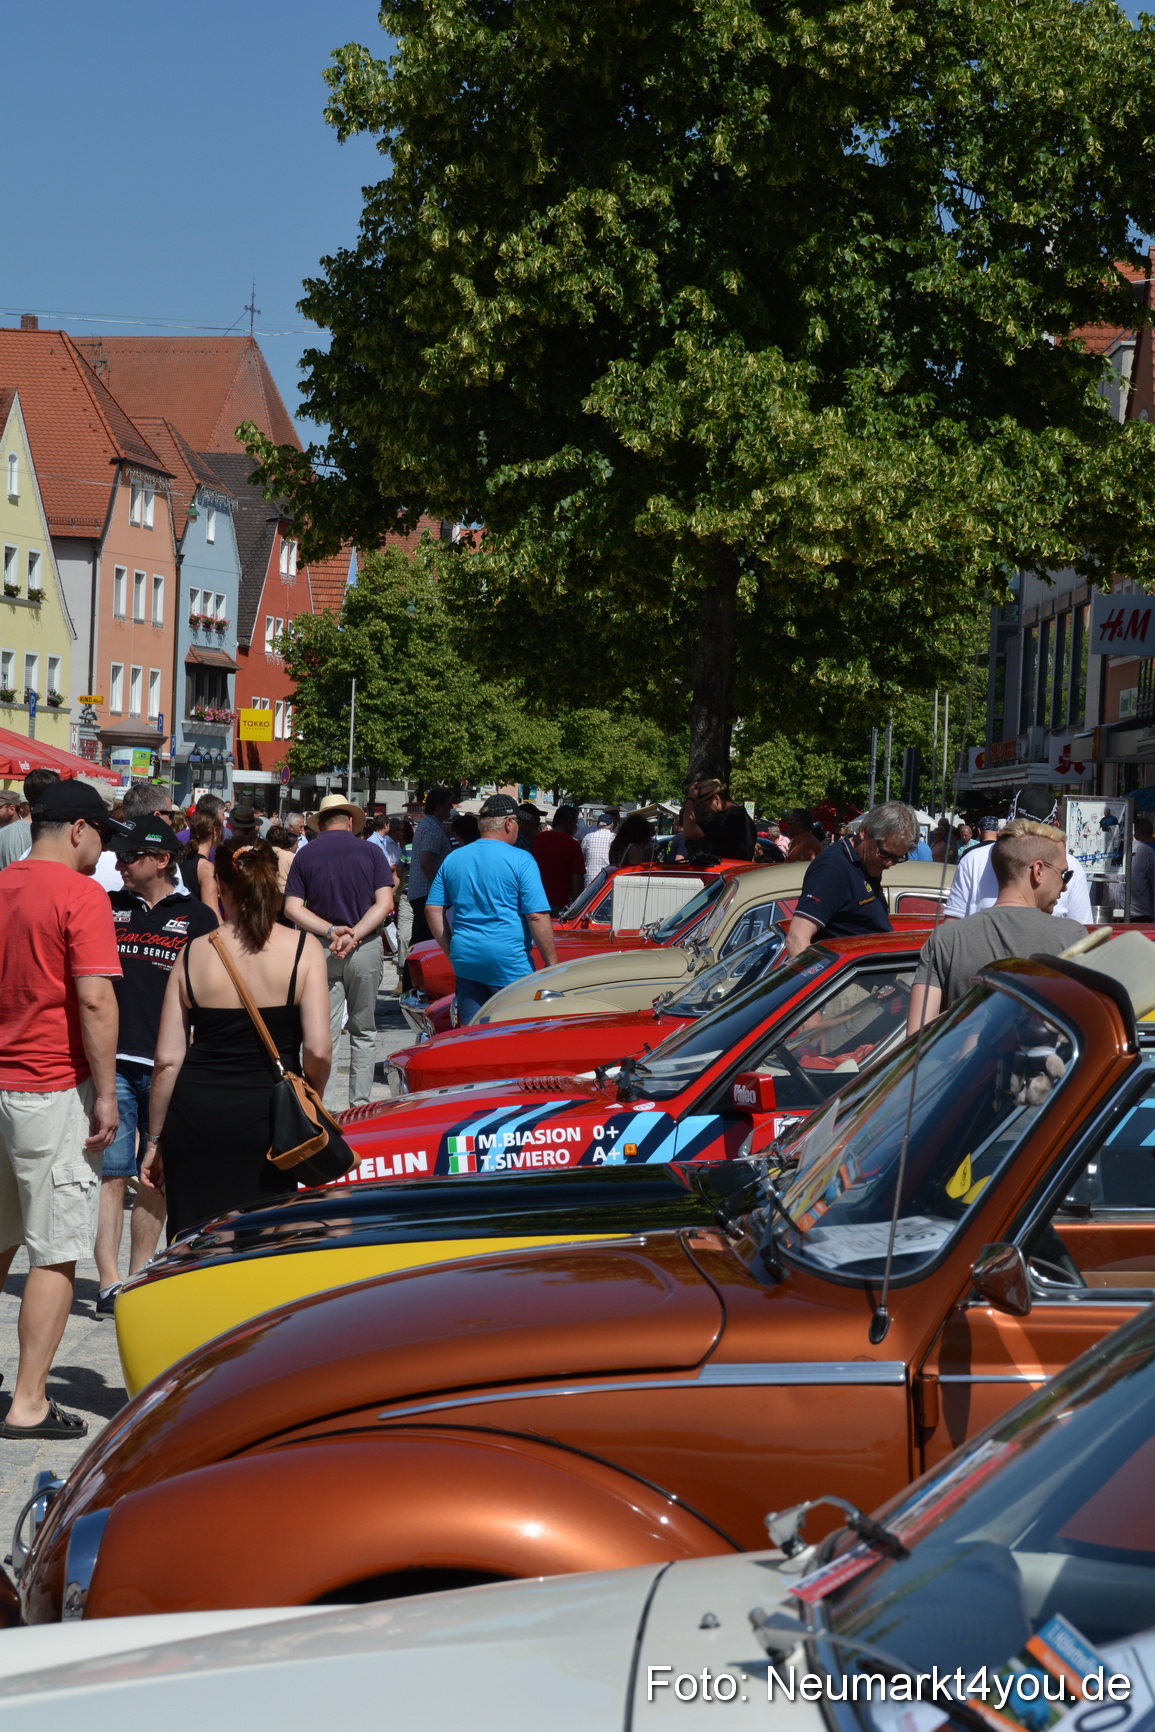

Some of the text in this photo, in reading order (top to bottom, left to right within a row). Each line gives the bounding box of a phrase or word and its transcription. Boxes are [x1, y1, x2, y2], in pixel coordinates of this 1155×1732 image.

[1100, 608, 1152, 643] H&M
[143, 947, 177, 961] SERIES
[733, 1084, 757, 1104] Valeo
[478, 1127, 581, 1149] M.BIASION
[481, 1146, 621, 1171] T.SIVIERO A+
